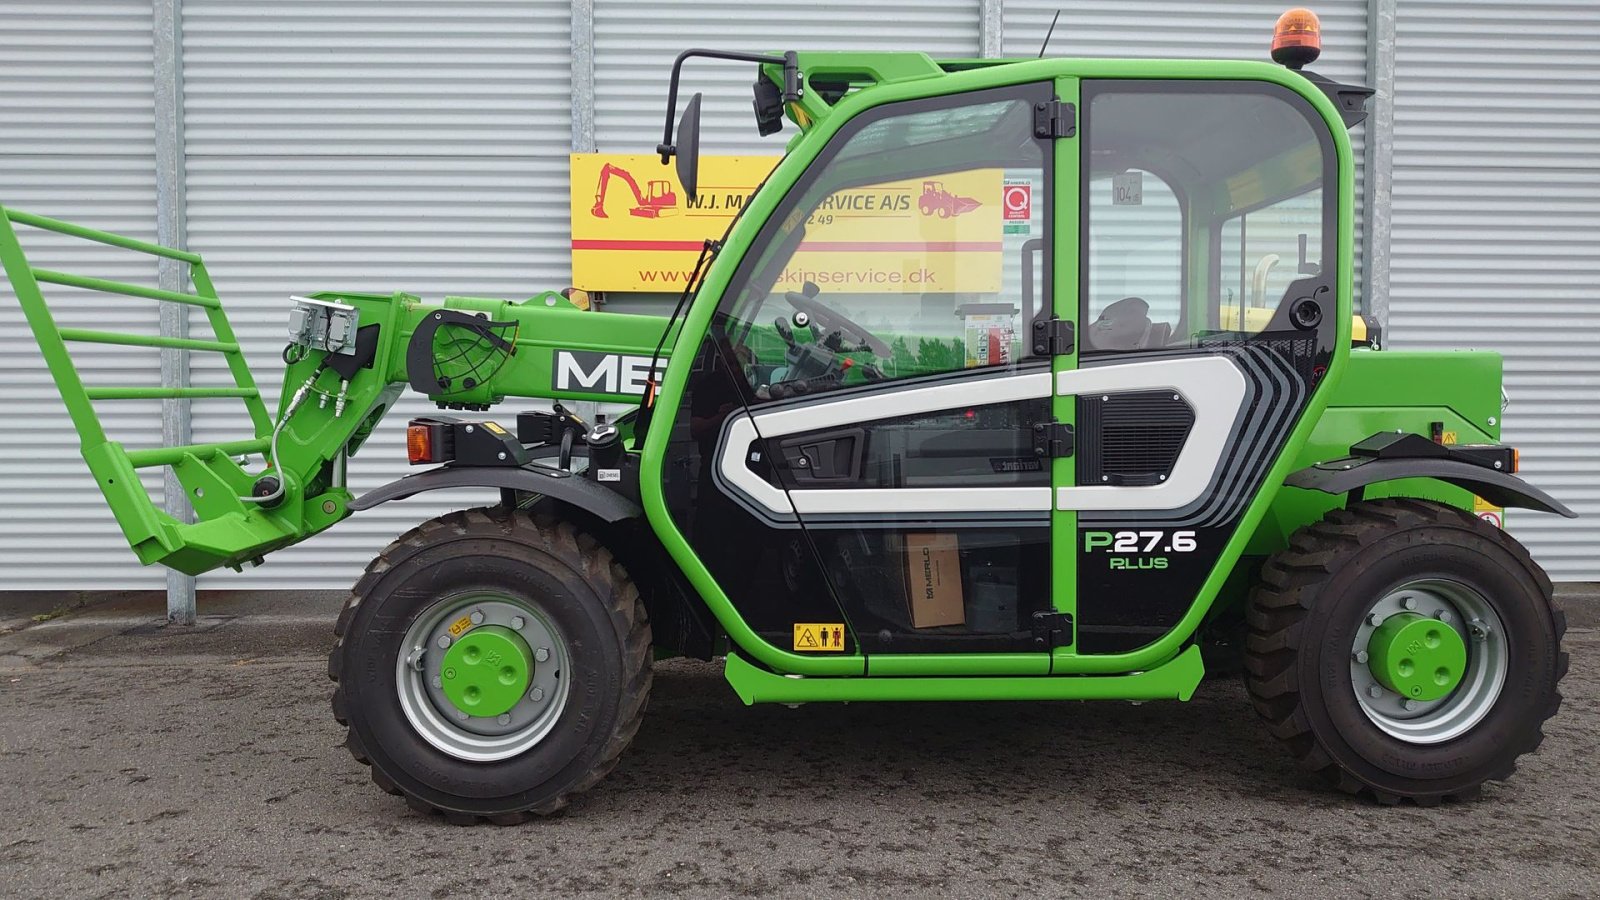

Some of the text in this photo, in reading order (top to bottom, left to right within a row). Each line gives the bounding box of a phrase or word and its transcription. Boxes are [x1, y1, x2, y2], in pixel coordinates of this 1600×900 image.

[1005, 187, 1028, 211] Q
[1116, 186, 1131, 202] 104
[880, 195, 910, 210] A/S
[817, 214, 833, 225] 49
[923, 547, 932, 587] MERLO
[1110, 557, 1169, 570] PLUS
